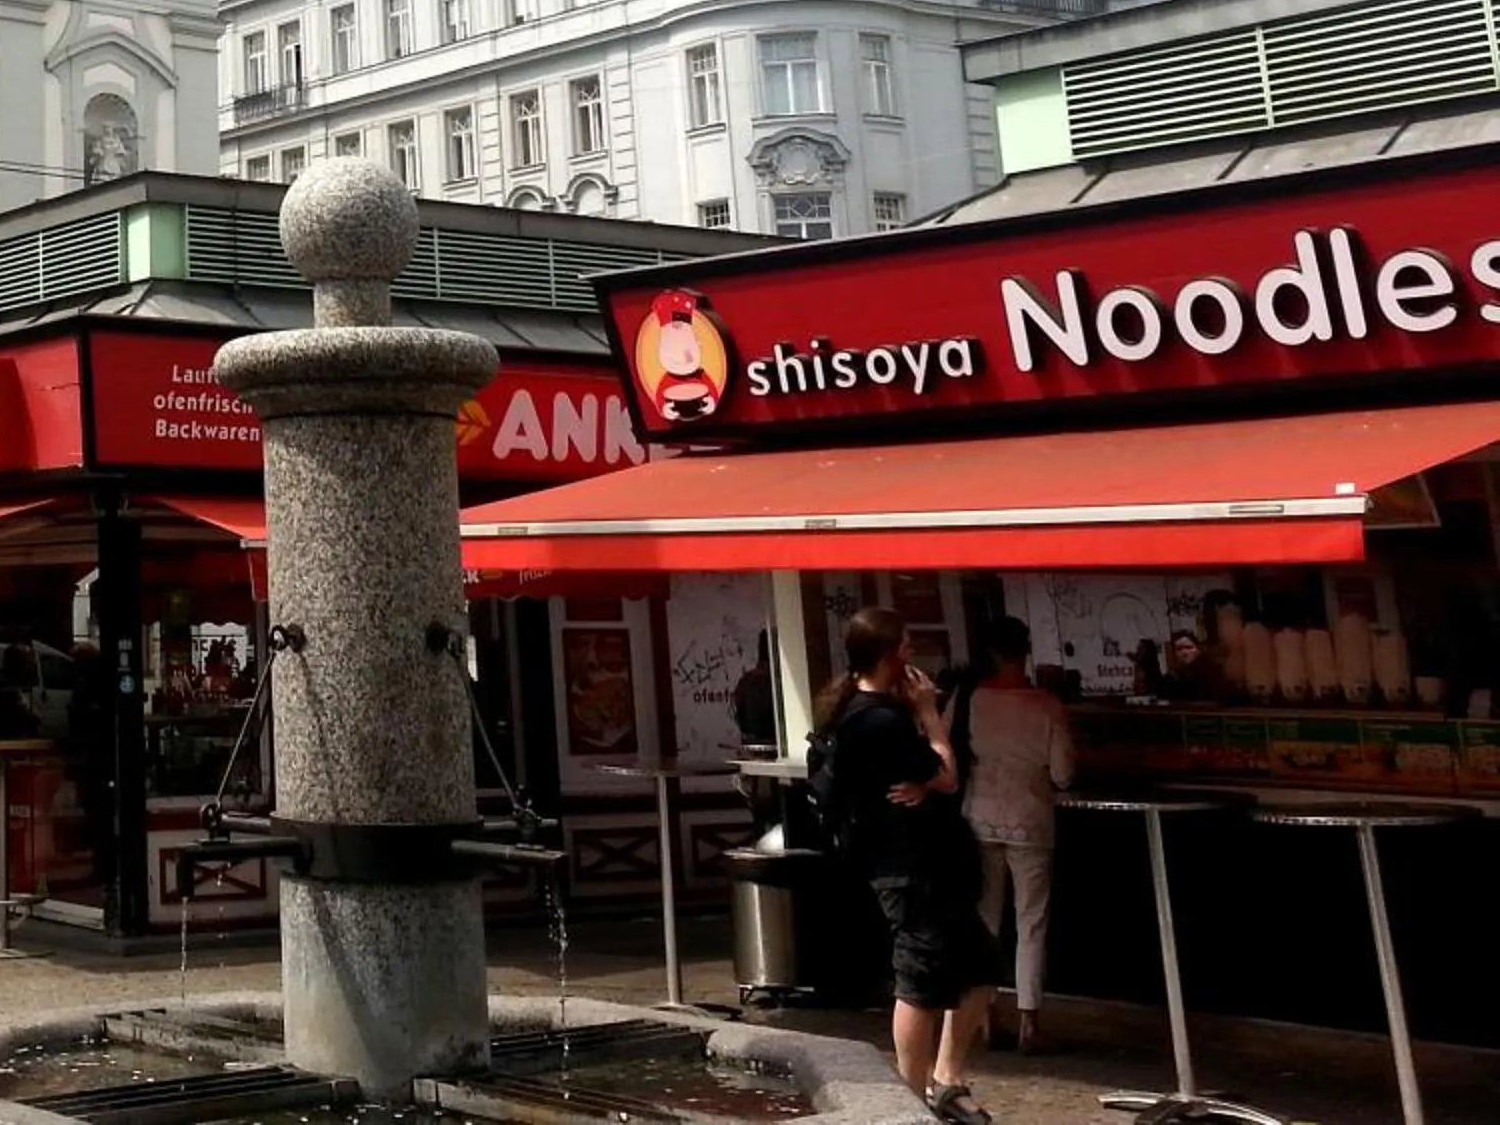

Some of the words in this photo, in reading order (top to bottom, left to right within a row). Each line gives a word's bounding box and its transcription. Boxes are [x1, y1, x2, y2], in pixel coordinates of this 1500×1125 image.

[747, 339, 973, 395] shisoya
[155, 418, 260, 442] Backwaren
[492, 389, 690, 465] ANK
